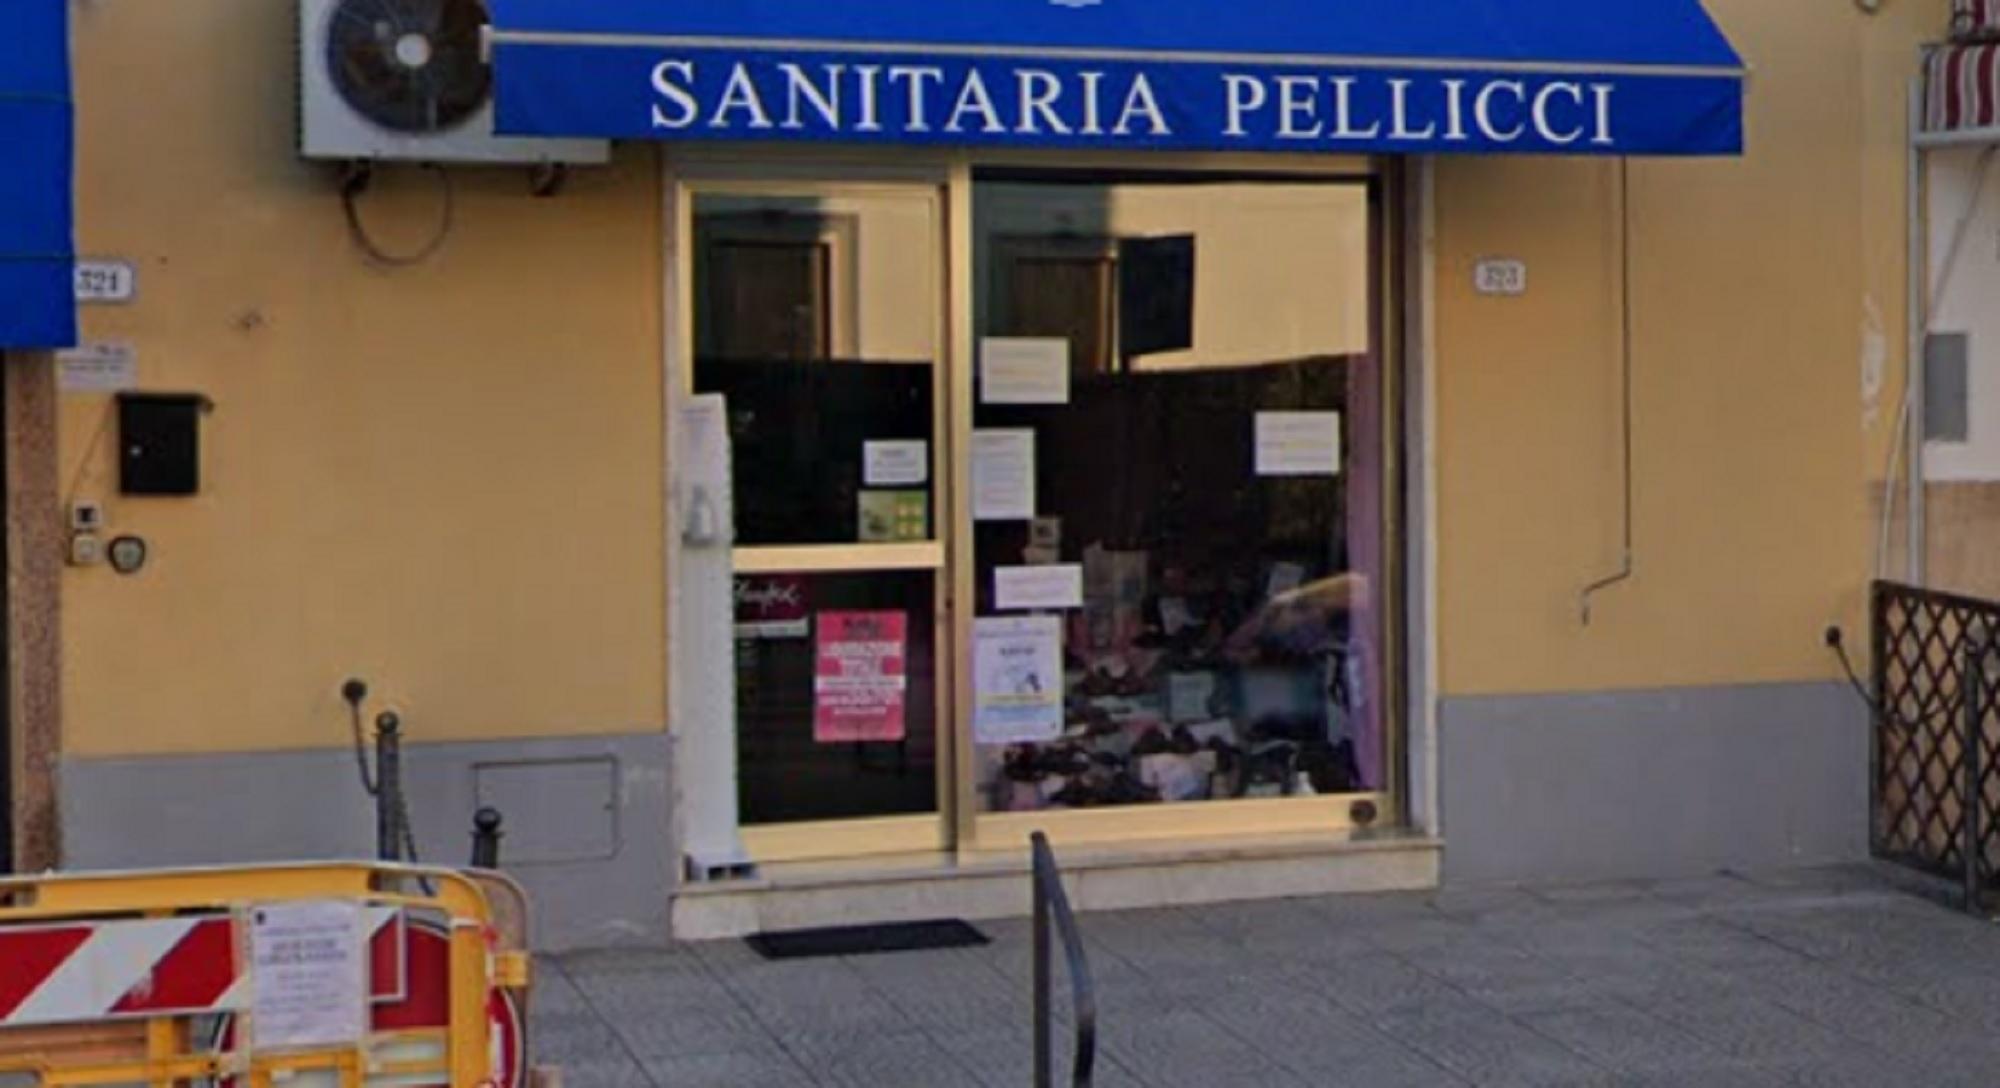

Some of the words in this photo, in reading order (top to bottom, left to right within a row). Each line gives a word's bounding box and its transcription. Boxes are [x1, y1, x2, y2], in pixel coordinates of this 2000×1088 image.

[650, 59, 1169, 136] SANITARIA
[1224, 74, 1615, 144] PELLICCI
[79, 269, 118, 293] 321
